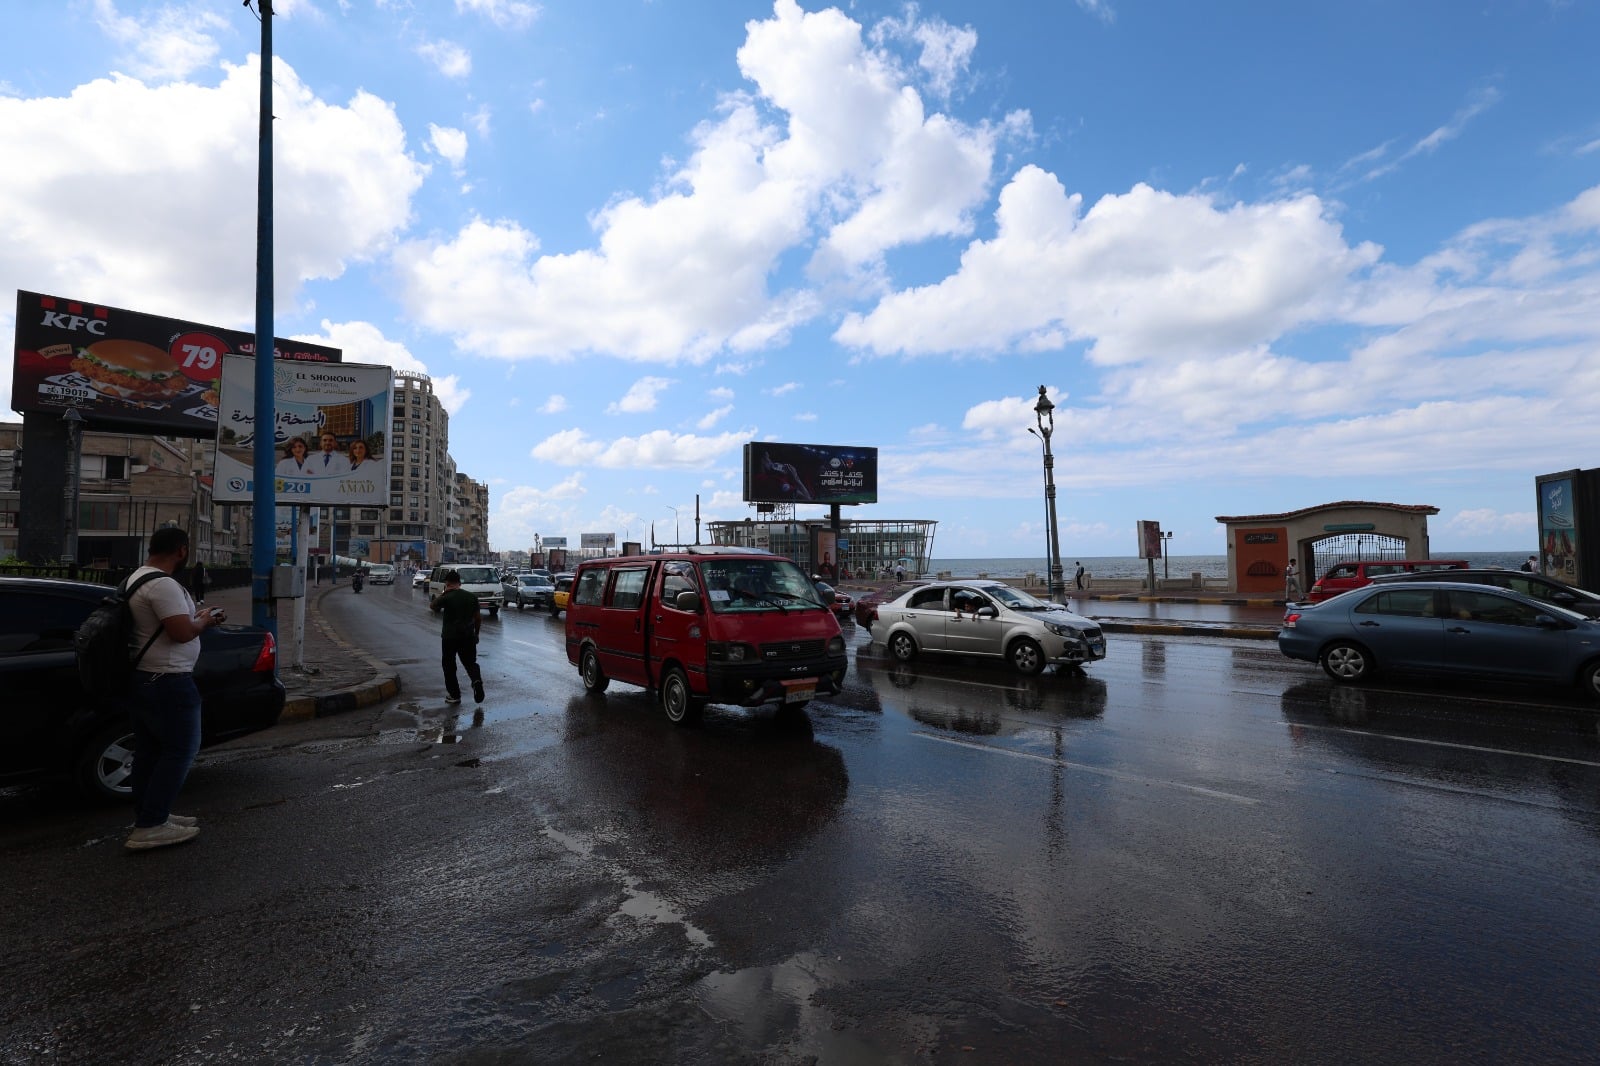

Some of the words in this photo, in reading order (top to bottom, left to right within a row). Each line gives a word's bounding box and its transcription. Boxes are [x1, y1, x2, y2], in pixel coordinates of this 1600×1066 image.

[40, 310, 107, 336] KFC
[182, 344, 217, 370] 79
[310, 373, 357, 383] SHOROUK
[60, 387, 89, 397] 19019
[281, 410, 326, 426] النسخة
[337, 483, 376, 493] AMAD
